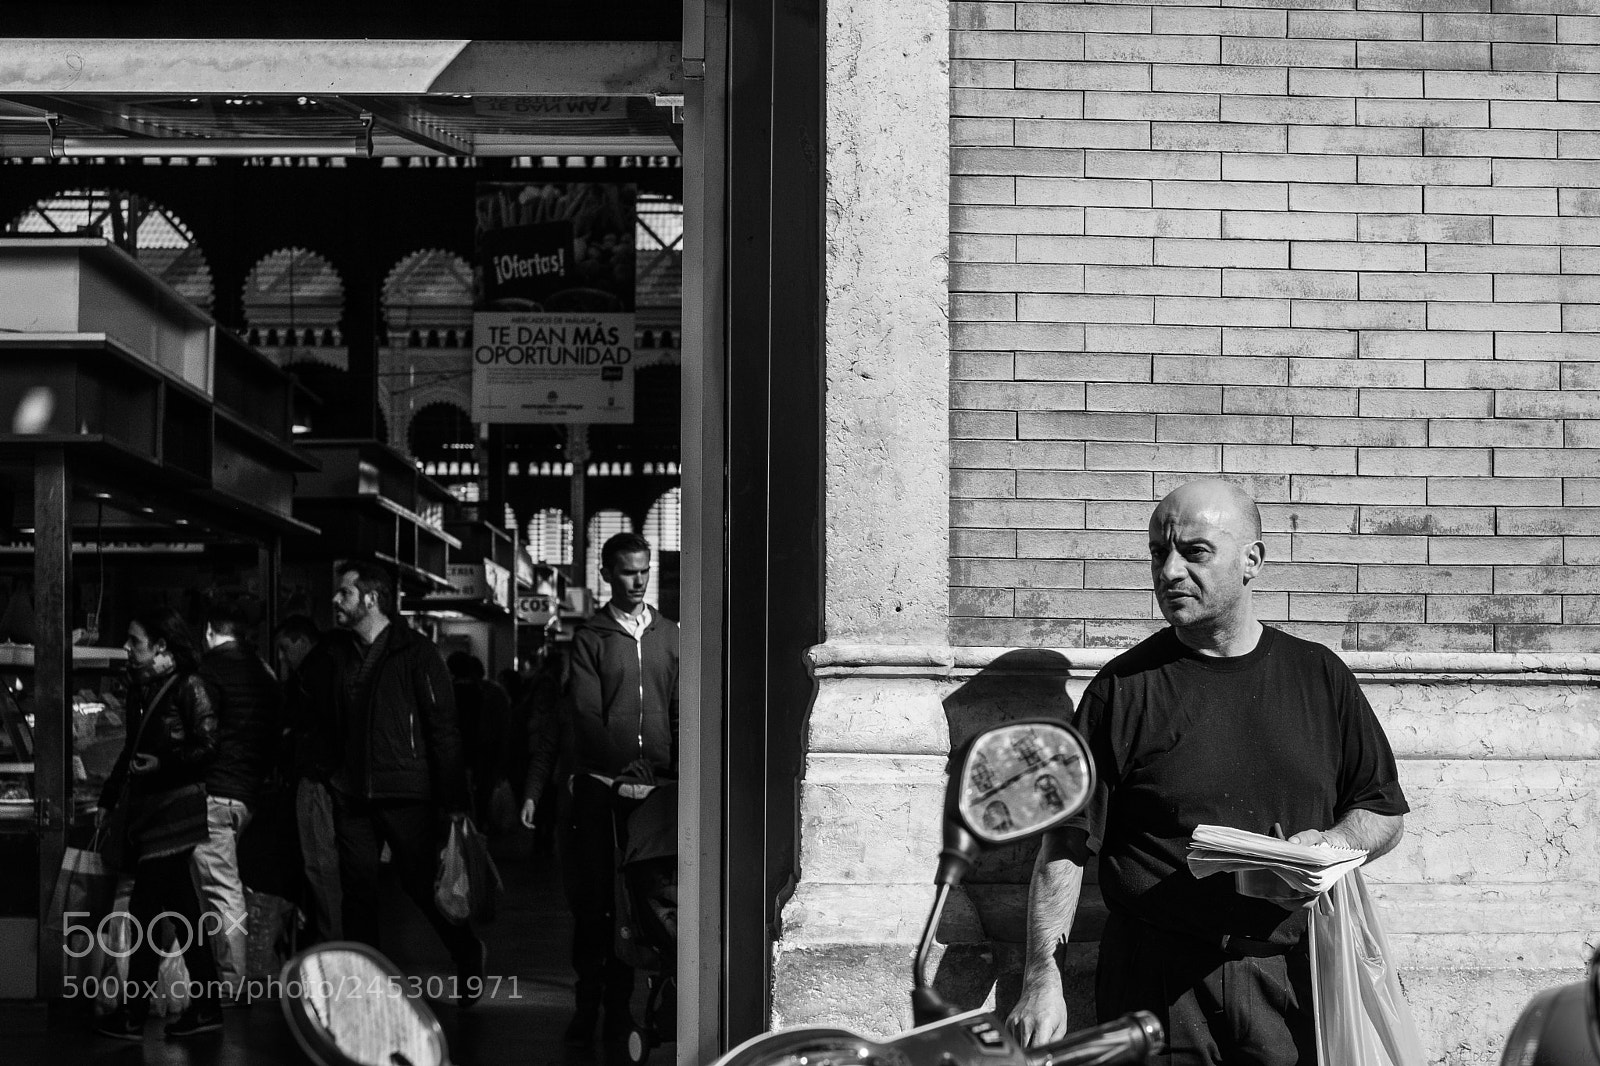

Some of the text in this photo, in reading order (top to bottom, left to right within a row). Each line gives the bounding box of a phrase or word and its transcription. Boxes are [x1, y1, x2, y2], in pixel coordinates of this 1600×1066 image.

[493, 248, 565, 285] ¡Ofertas!
[488, 321, 620, 345] TE DAN MÁS
[475, 345, 632, 365] OPORTUNIDAD
